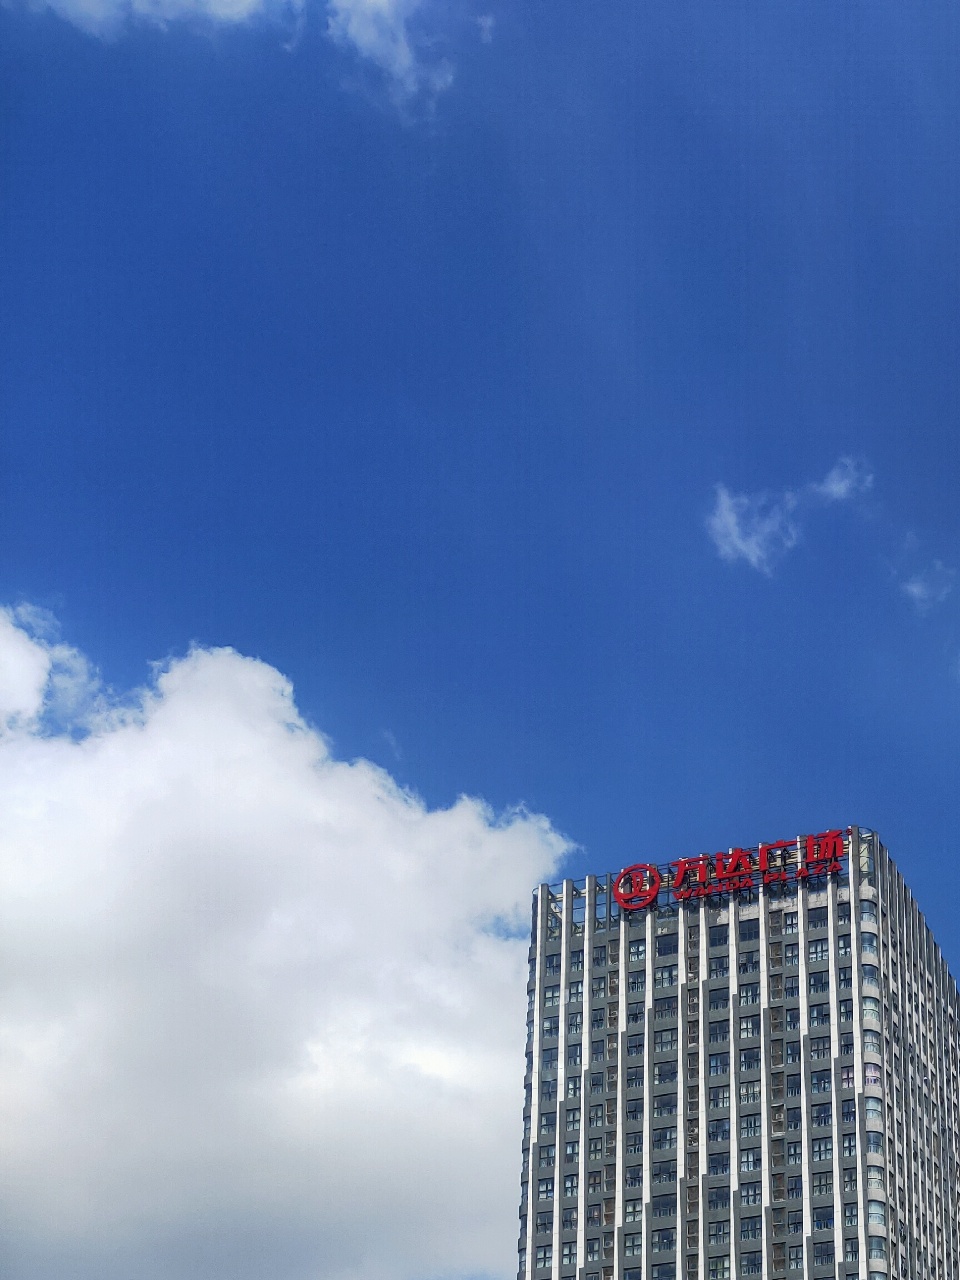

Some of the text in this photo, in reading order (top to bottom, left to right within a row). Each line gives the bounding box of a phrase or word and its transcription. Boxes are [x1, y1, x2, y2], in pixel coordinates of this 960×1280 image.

[671, 829, 844, 888] 万达广场
[672, 860, 844, 900] WANDA PLAZA
